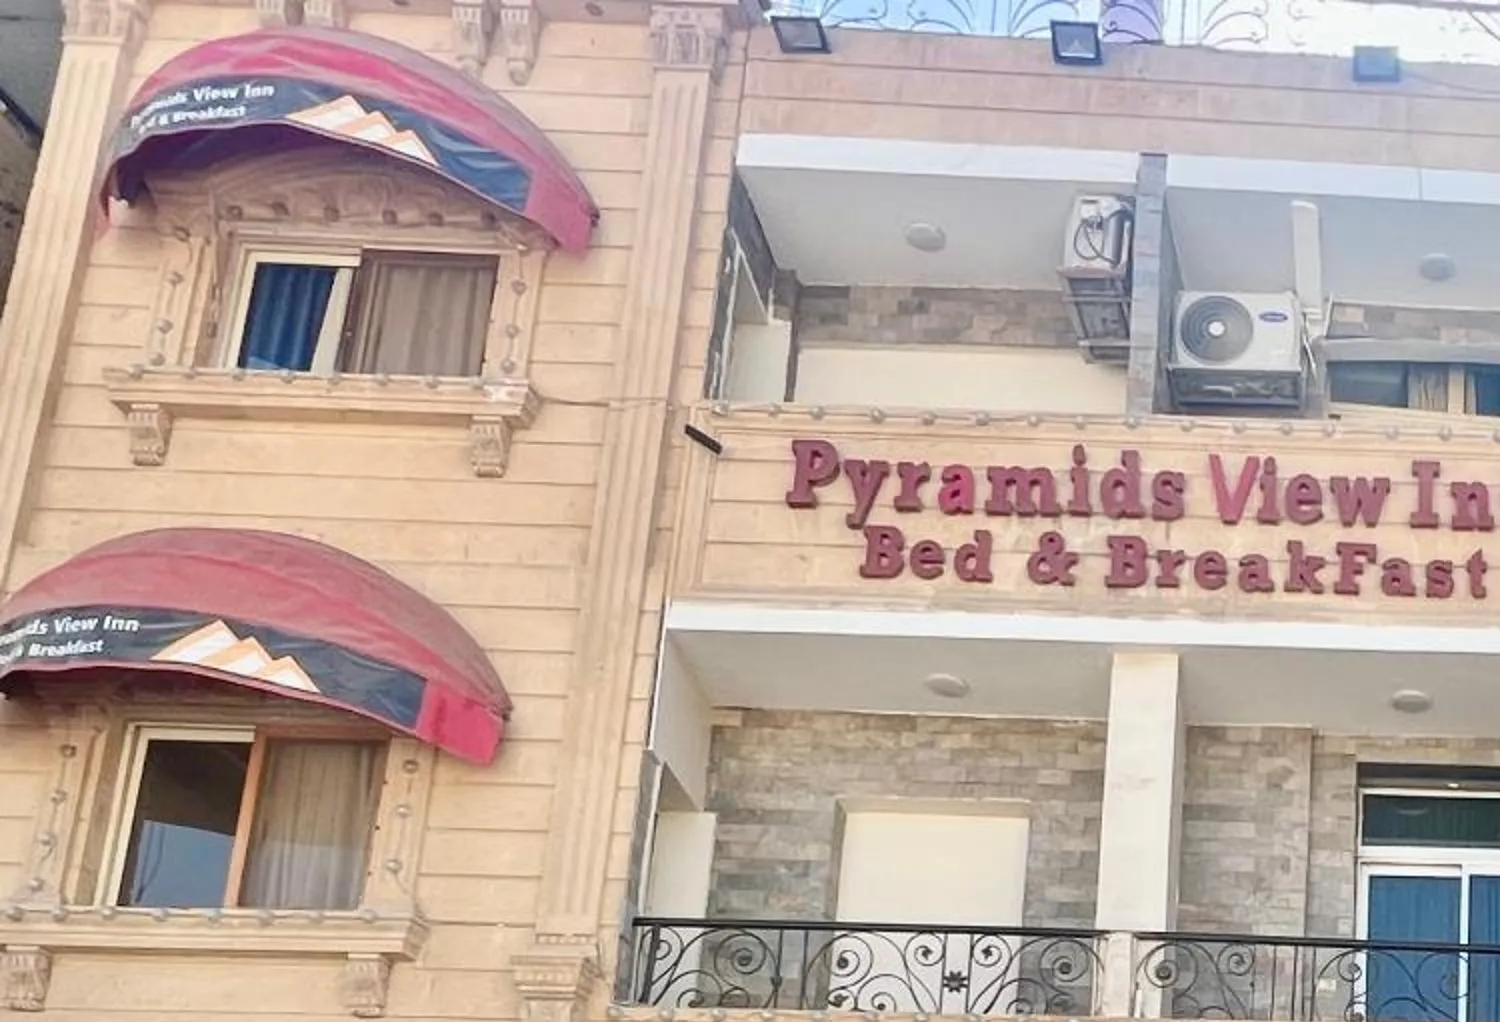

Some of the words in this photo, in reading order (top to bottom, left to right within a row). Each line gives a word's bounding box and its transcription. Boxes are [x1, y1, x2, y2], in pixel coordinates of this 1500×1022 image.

[193, 86, 240, 101] View
[244, 82, 275, 98] Inn
[786, 439, 1185, 529] Pyramids
[1208, 453, 1392, 528] View
[859, 525, 994, 583] Bed
[1027, 531, 1079, 586] &
[53, 616, 99, 634] View
[103, 615, 140, 632] Inn
[28, 640, 105, 657] Breakfast
